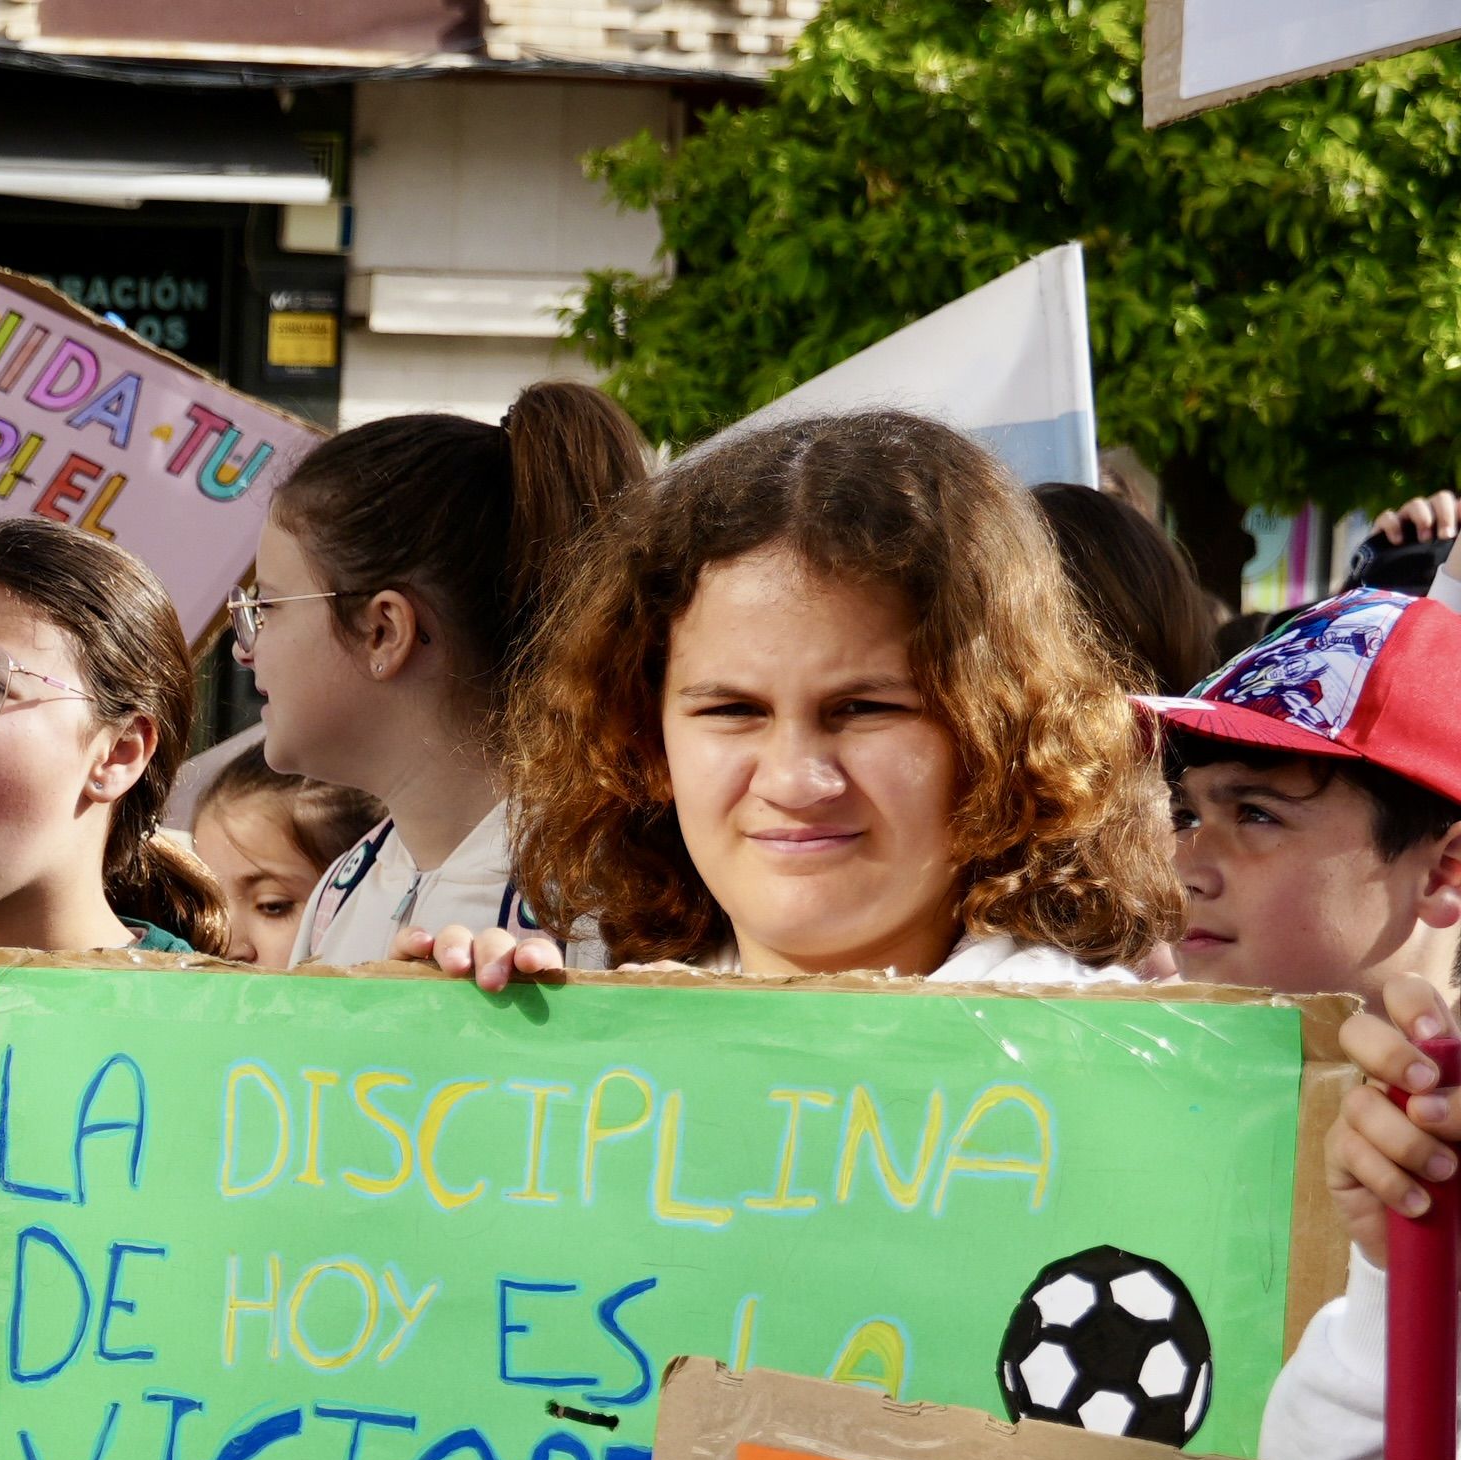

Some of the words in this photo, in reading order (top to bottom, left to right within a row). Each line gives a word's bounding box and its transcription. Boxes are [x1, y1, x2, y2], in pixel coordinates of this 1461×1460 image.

[45, 271, 210, 312] RACIÓN
[166, 402, 275, 502] TU
[219, 1067, 1053, 1226] DISCIPLINA
[10, 1224, 166, 1385] DE
[224, 1252, 439, 1371] HOY
[498, 1277, 658, 1405] ES
